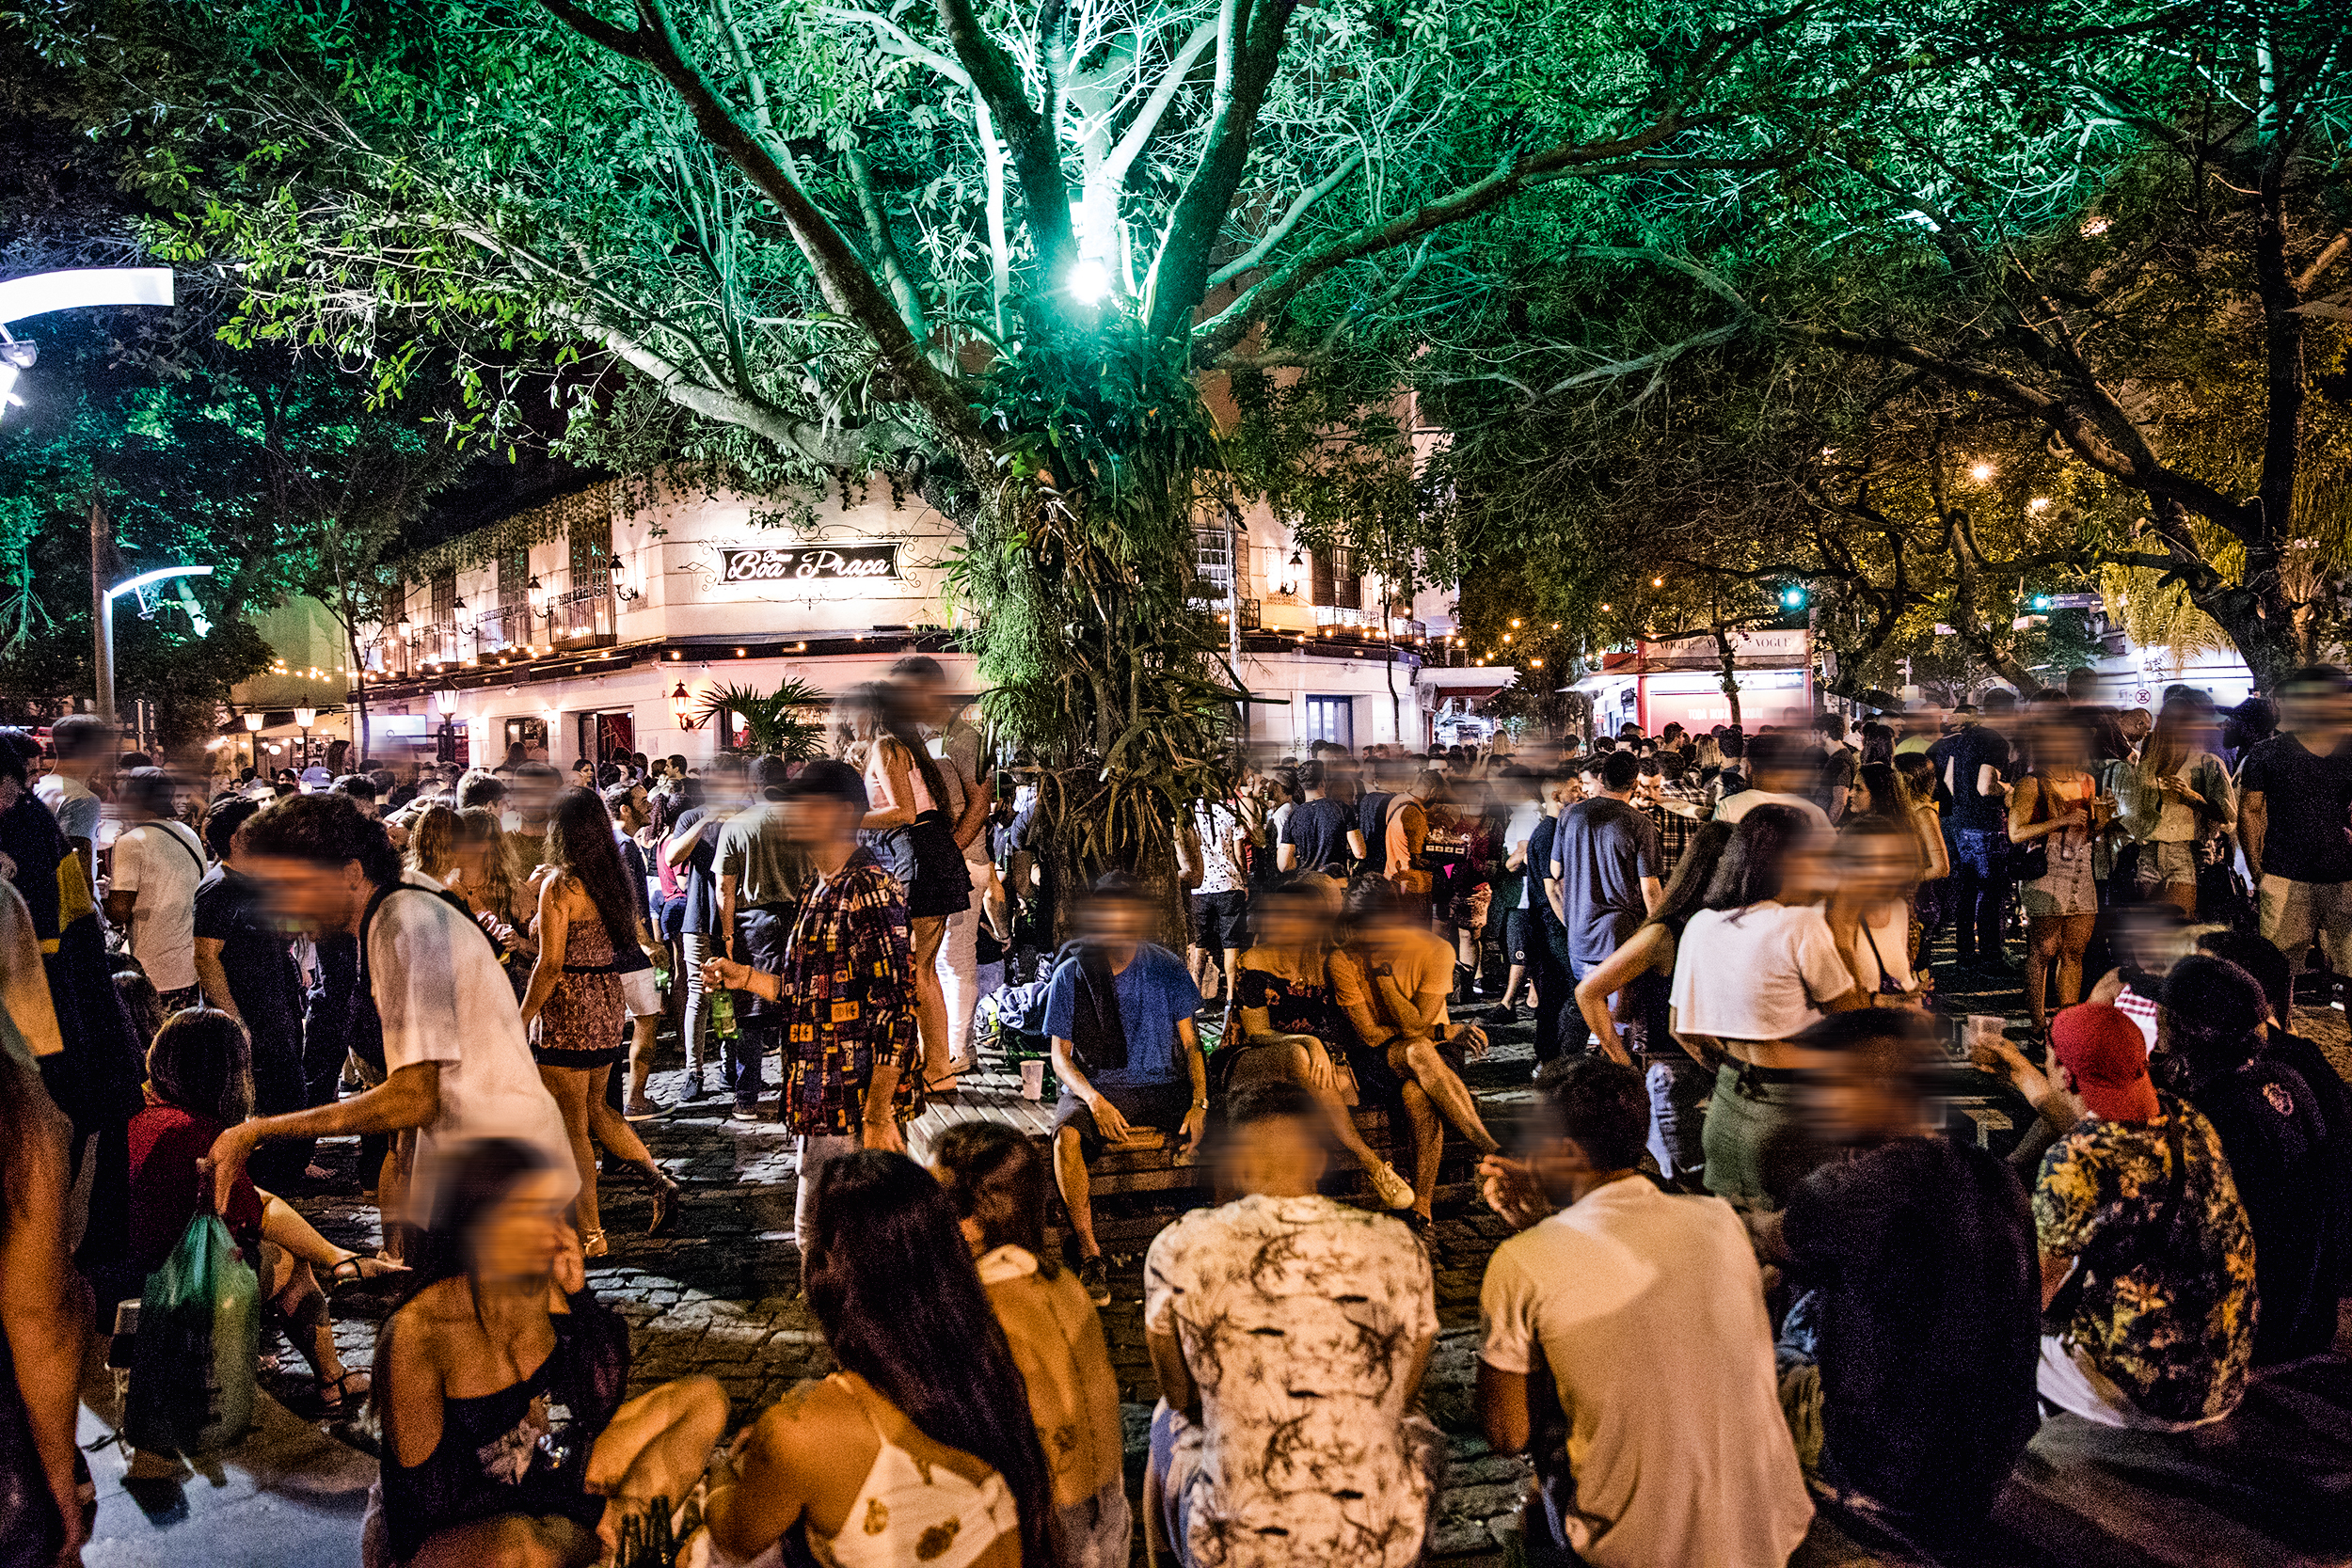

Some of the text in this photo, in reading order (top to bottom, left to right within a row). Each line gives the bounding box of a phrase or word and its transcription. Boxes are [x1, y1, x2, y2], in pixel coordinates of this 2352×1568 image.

[727, 551, 786, 580] Boa
[796, 550, 891, 579] Praça
[1660, 641, 1694, 650] VOGUE
[1755, 638, 1791, 647] VOGUE
[1688, 708, 1708, 720] TODA
